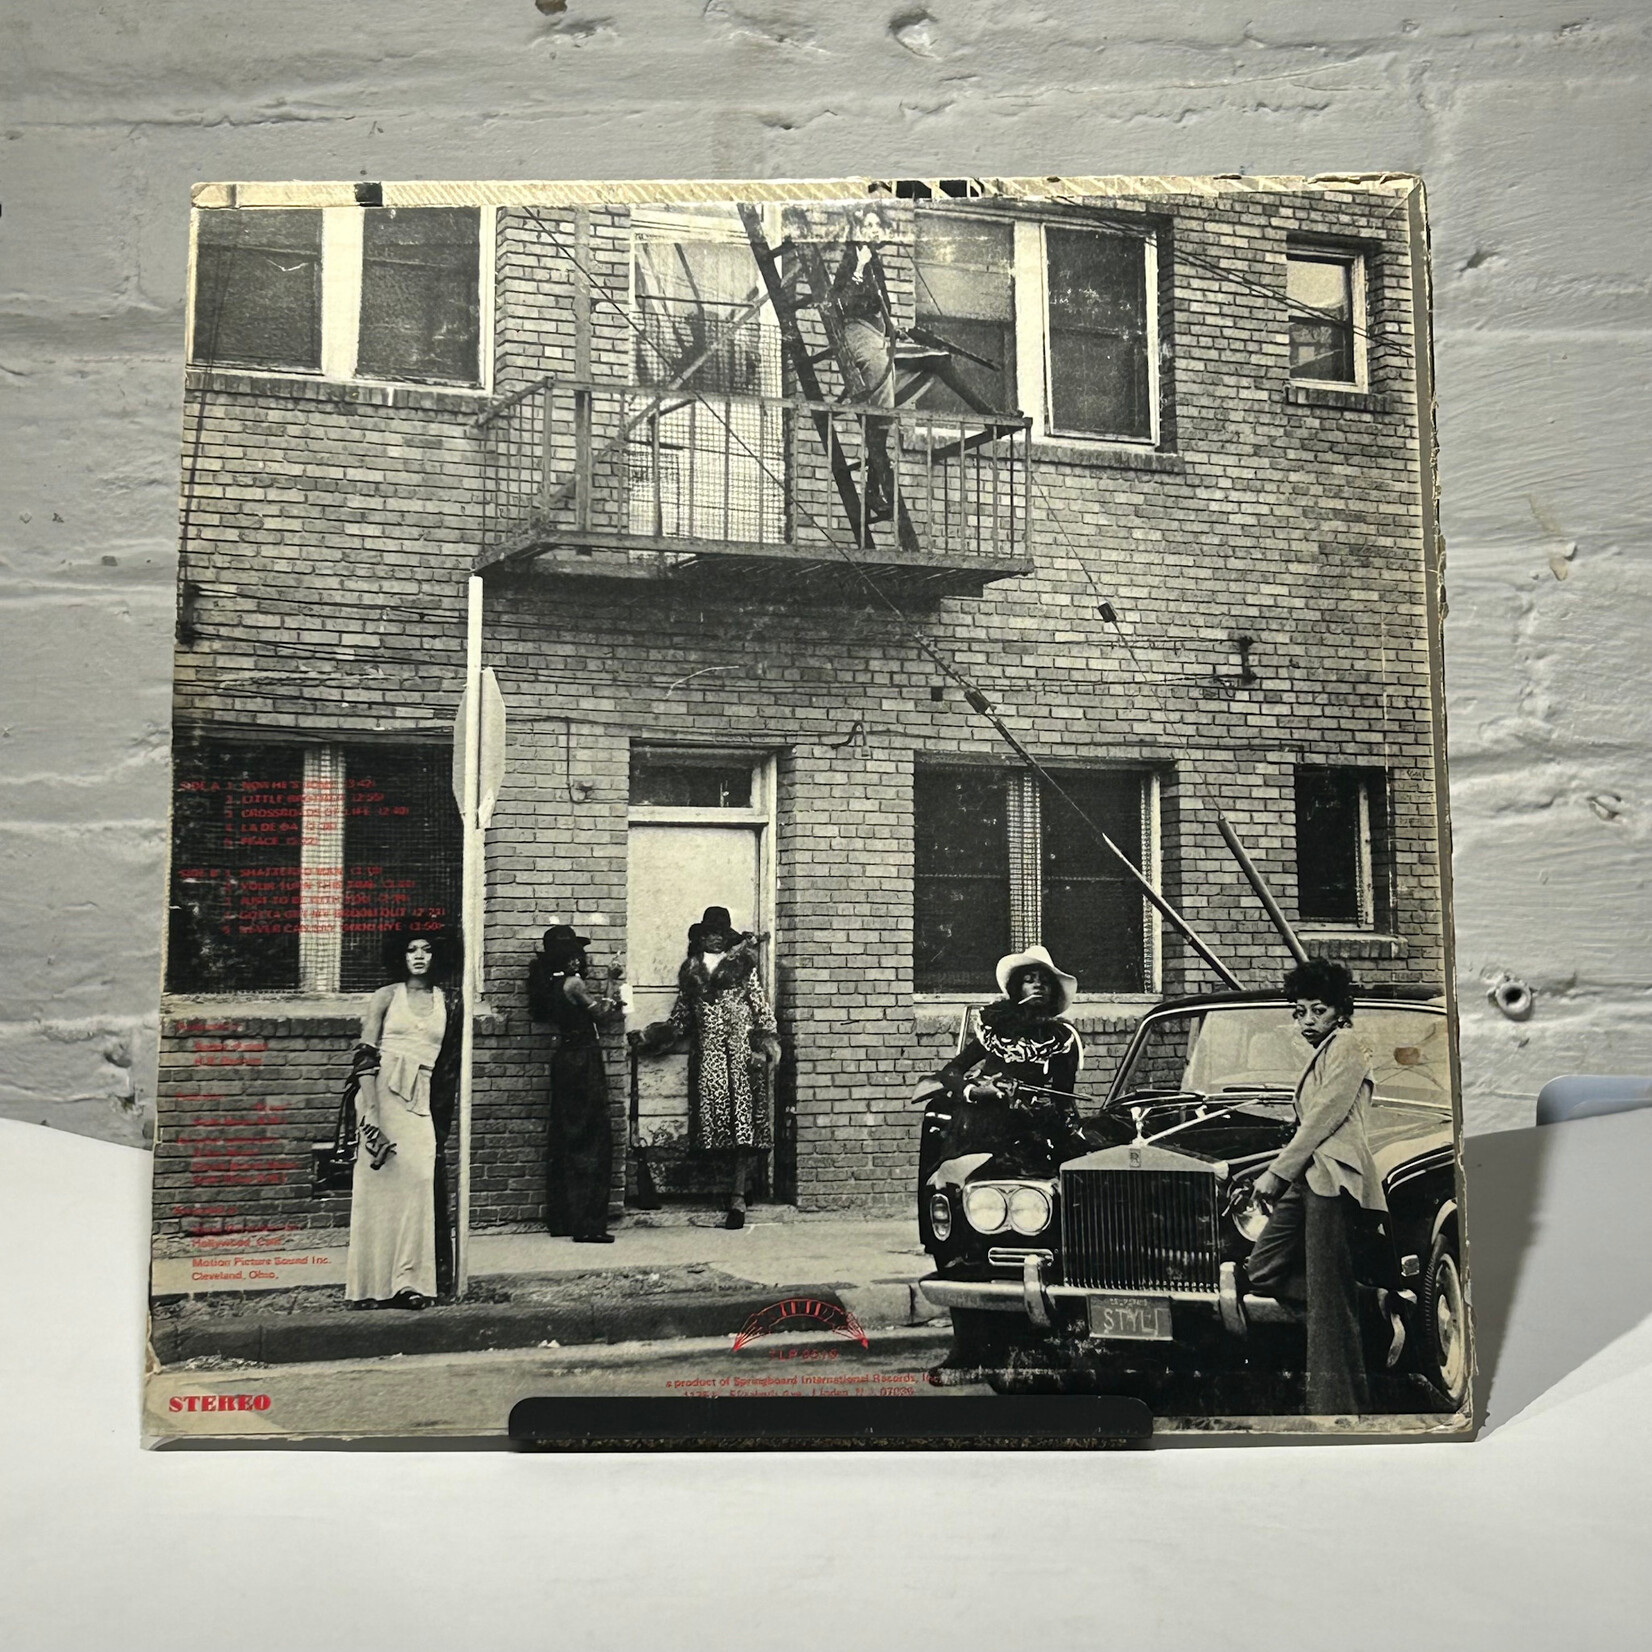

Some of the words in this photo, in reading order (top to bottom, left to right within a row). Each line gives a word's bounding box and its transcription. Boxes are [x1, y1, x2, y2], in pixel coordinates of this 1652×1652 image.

[192, 1257, 231, 1268] Motion
[234, 1256, 271, 1267] Picture
[274, 1256, 308, 1266] Sound
[312, 1255, 332, 1265] Inc.
[674, 1376, 717, 1389] product
[719, 1375, 731, 1387] of
[733, 1374, 798, 1389] Springboard
[801, 1373, 870, 1386] International
[168, 1393, 272, 1413] STEREO
